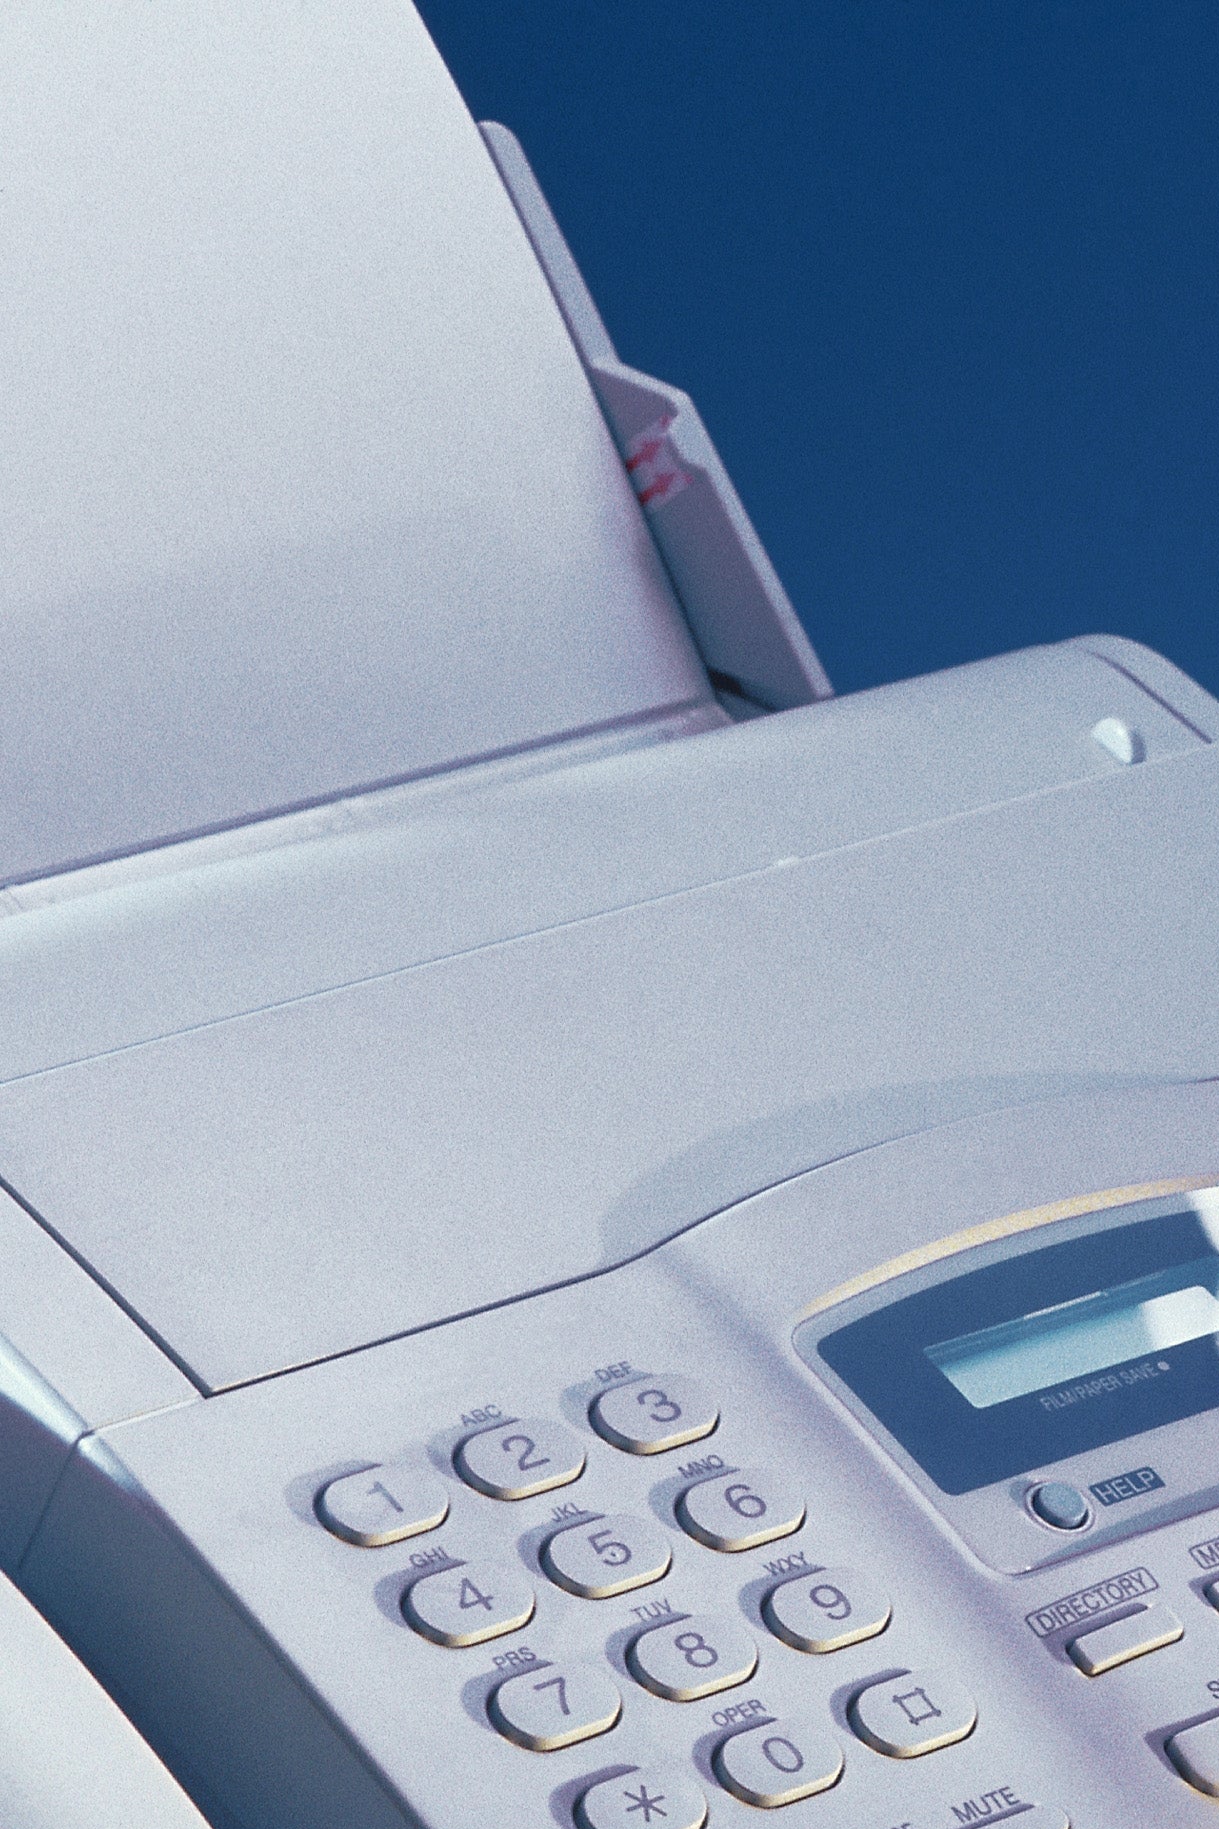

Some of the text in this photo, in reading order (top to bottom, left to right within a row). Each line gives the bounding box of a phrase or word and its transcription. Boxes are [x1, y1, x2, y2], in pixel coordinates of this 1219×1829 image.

[593, 1361, 636, 1386] DEF
[1121, 1360, 1158, 1388] SAVE
[459, 1403, 503, 1429] ABC
[635, 1388, 683, 1422] 3
[502, 1434, 551, 1472] 2
[678, 1454, 725, 1480] MNO
[367, 1481, 405, 1514] 1
[723, 1483, 767, 1520] 6
[1096, 1469, 1158, 1503] HELP
[551, 1501, 590, 1524] JKL
[408, 1545, 452, 1570] GHI
[587, 1529, 632, 1568] 5
[763, 1550, 810, 1577] WXY
[457, 1577, 494, 1613] 4
[629, 1597, 672, 1622] TUV
[808, 1583, 853, 1621] 9
[1036, 1572, 1148, 1633] DIRECTORY
[492, 1644, 537, 1671] PRS
[674, 1631, 719, 1668] 8
[533, 1676, 574, 1717] 7
[711, 1698, 767, 1727] OPER
[761, 1735, 805, 1774] 0
[951, 1786, 1022, 1823] MUTE
